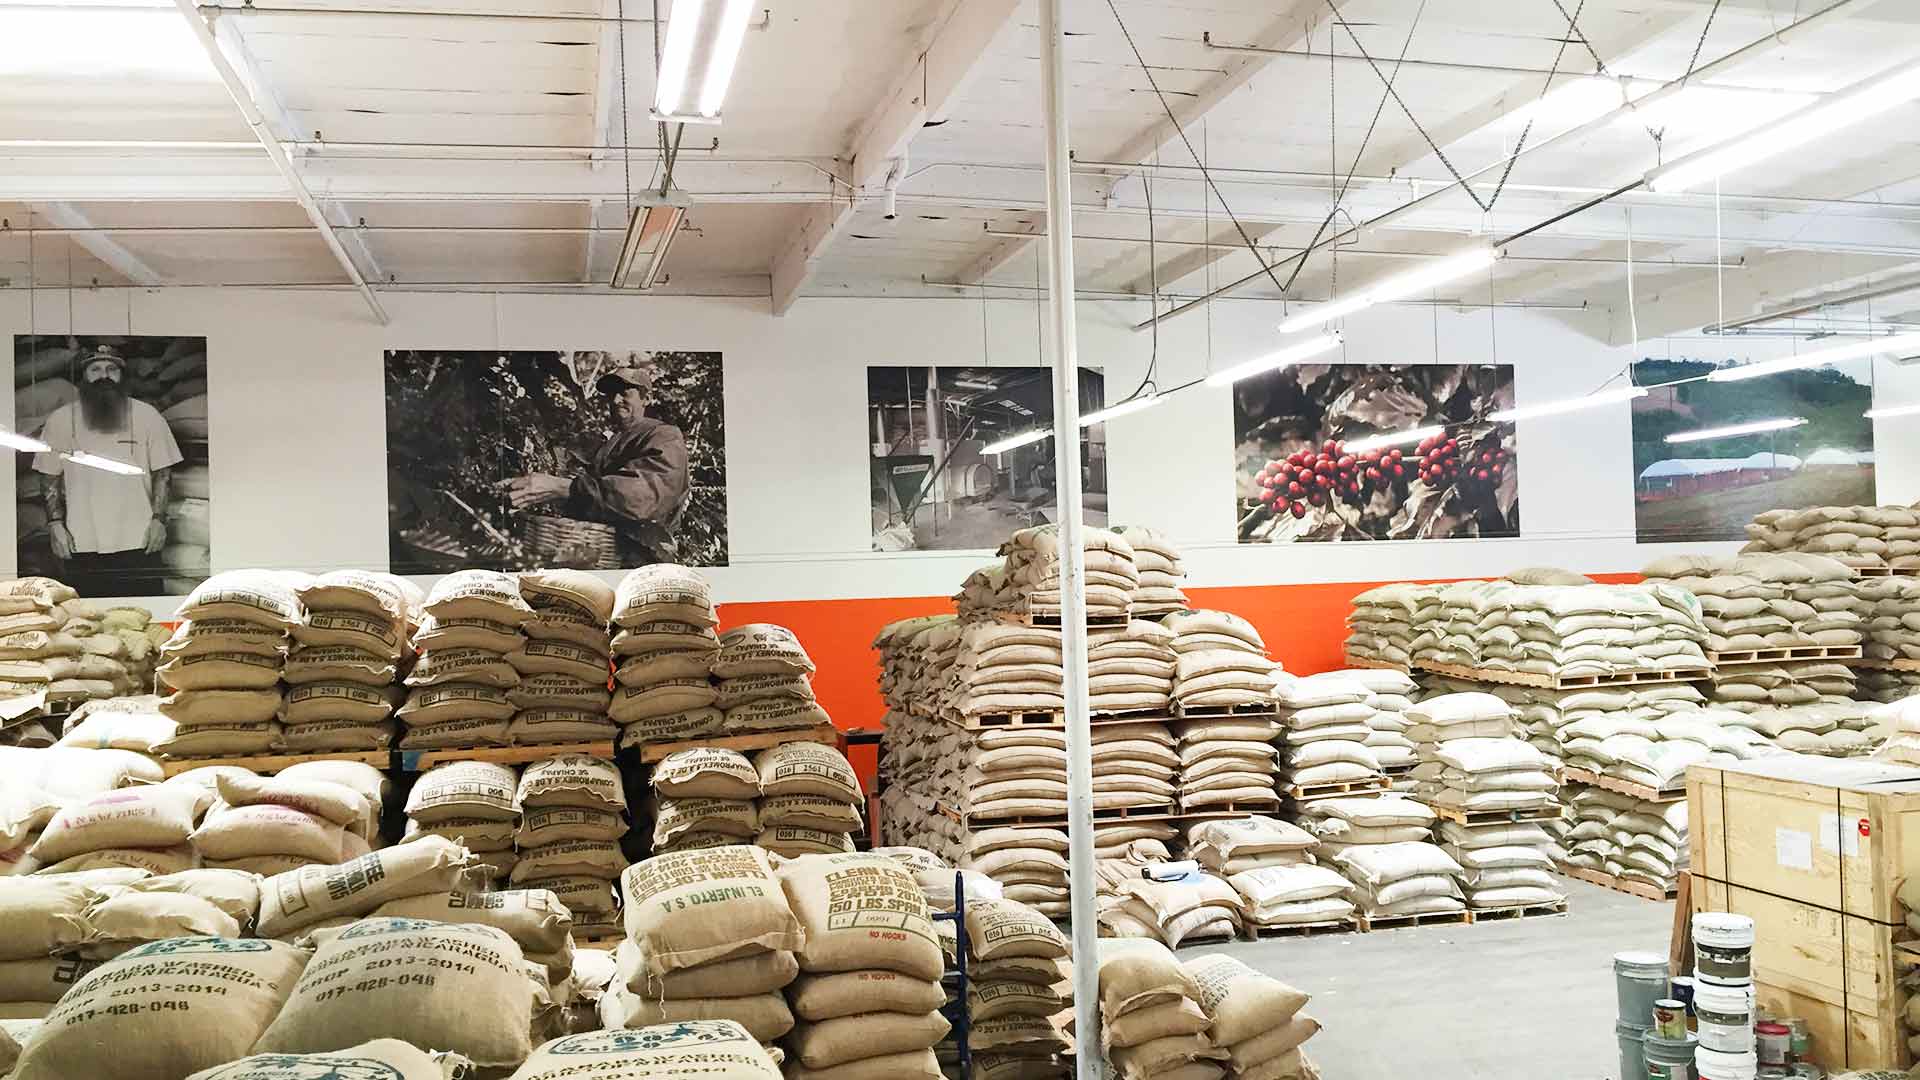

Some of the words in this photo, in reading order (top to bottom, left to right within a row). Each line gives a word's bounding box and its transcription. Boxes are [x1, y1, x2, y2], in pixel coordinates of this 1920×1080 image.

[747, 886, 764, 897] EL
[828, 899, 852, 914] 150
[869, 930, 880, 939] NO
[881, 932, 907, 941] HOOKS
[365, 957, 476, 975] 2013-2014
[109, 983, 229, 998] 2013-2014
